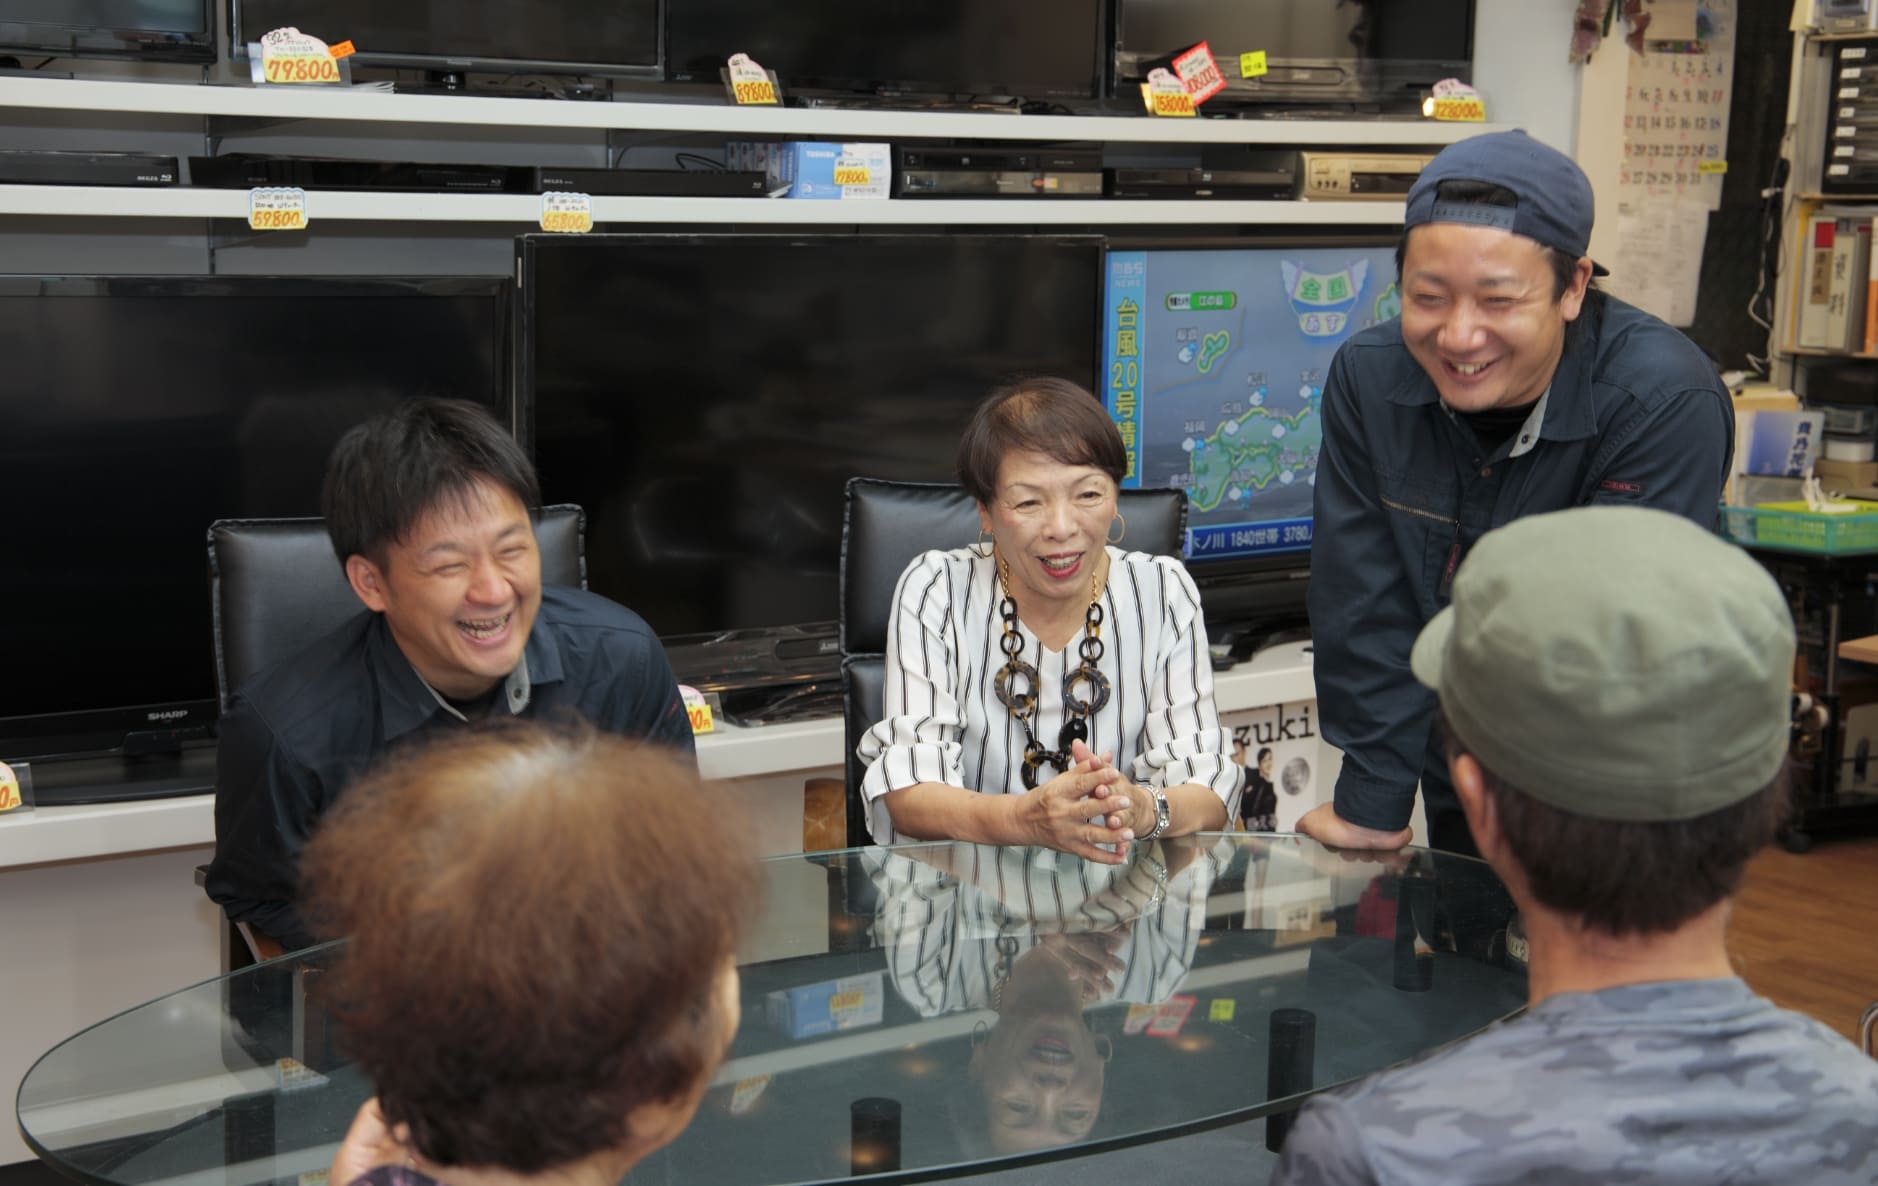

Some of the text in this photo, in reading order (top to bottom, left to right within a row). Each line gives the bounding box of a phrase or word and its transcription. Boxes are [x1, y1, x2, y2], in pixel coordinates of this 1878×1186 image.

[1300, 276, 1347, 301] 全国
[1306, 314, 1340, 333] あす
[148, 710, 188, 721] SHARP
[1234, 704, 1314, 747] zuki
